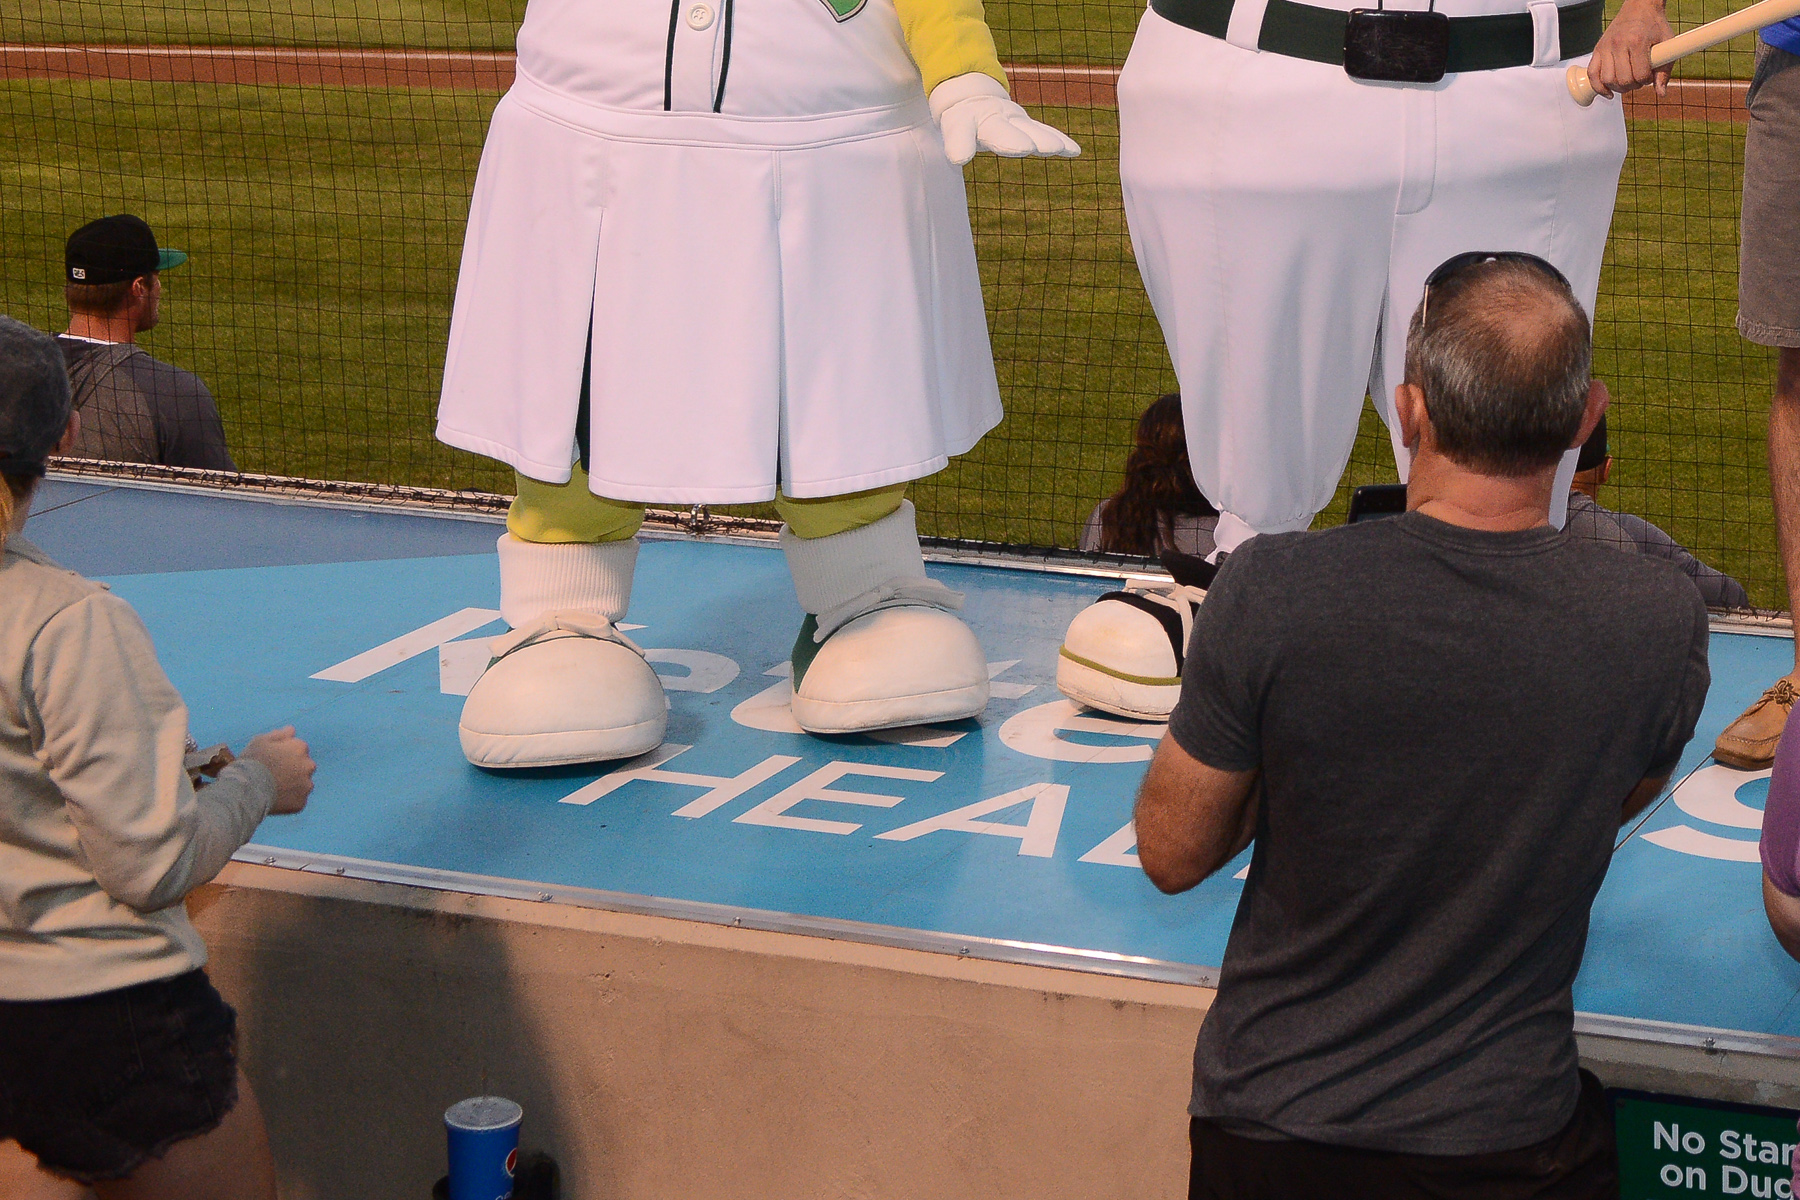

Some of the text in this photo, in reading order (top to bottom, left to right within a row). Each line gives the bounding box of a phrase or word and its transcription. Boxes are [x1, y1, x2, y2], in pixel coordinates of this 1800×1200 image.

[1653, 1121, 1705, 1155] No
[1660, 1164, 1794, 1200] on Dug
